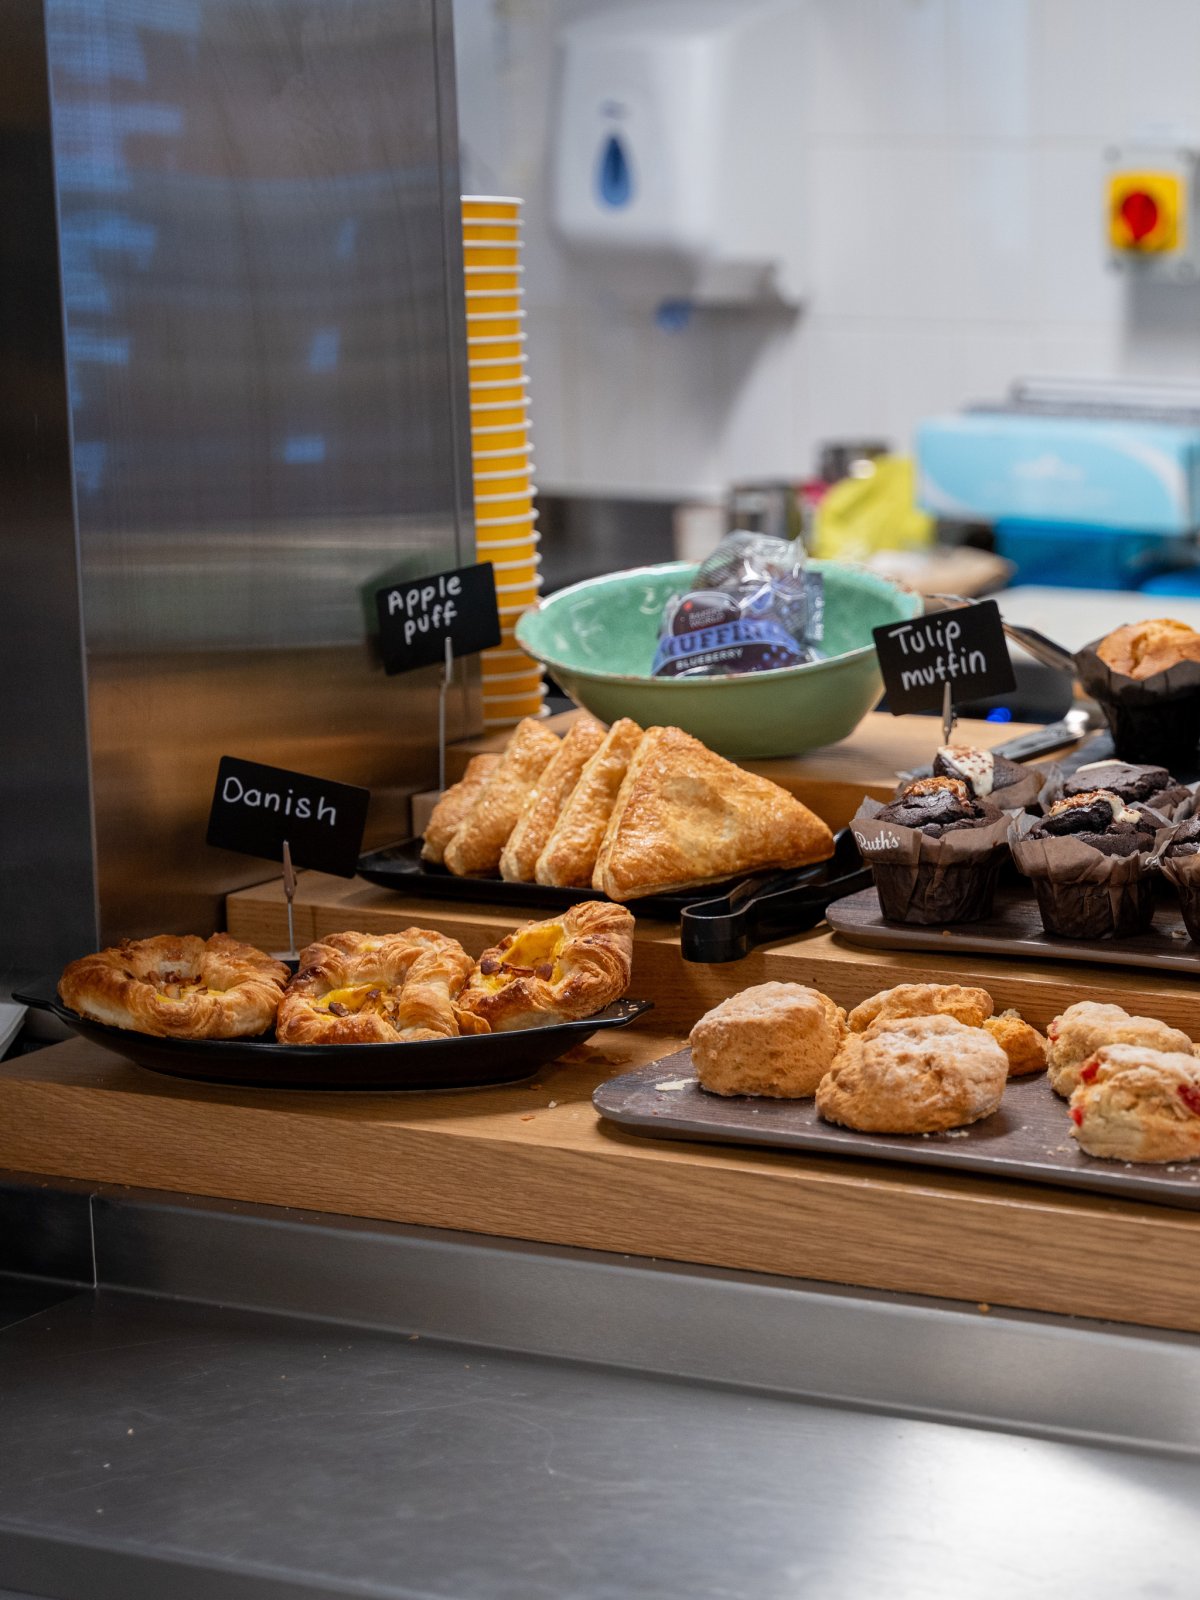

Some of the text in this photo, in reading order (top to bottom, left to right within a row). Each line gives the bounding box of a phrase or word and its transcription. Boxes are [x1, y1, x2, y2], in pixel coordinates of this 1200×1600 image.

[388, 576, 462, 618] Apple
[404, 600, 458, 646] puff
[888, 620, 960, 653] Tulip
[676, 648, 743, 670] BLUEBERRY
[901, 646, 986, 691] muffin
[222, 776, 336, 826] Danish
